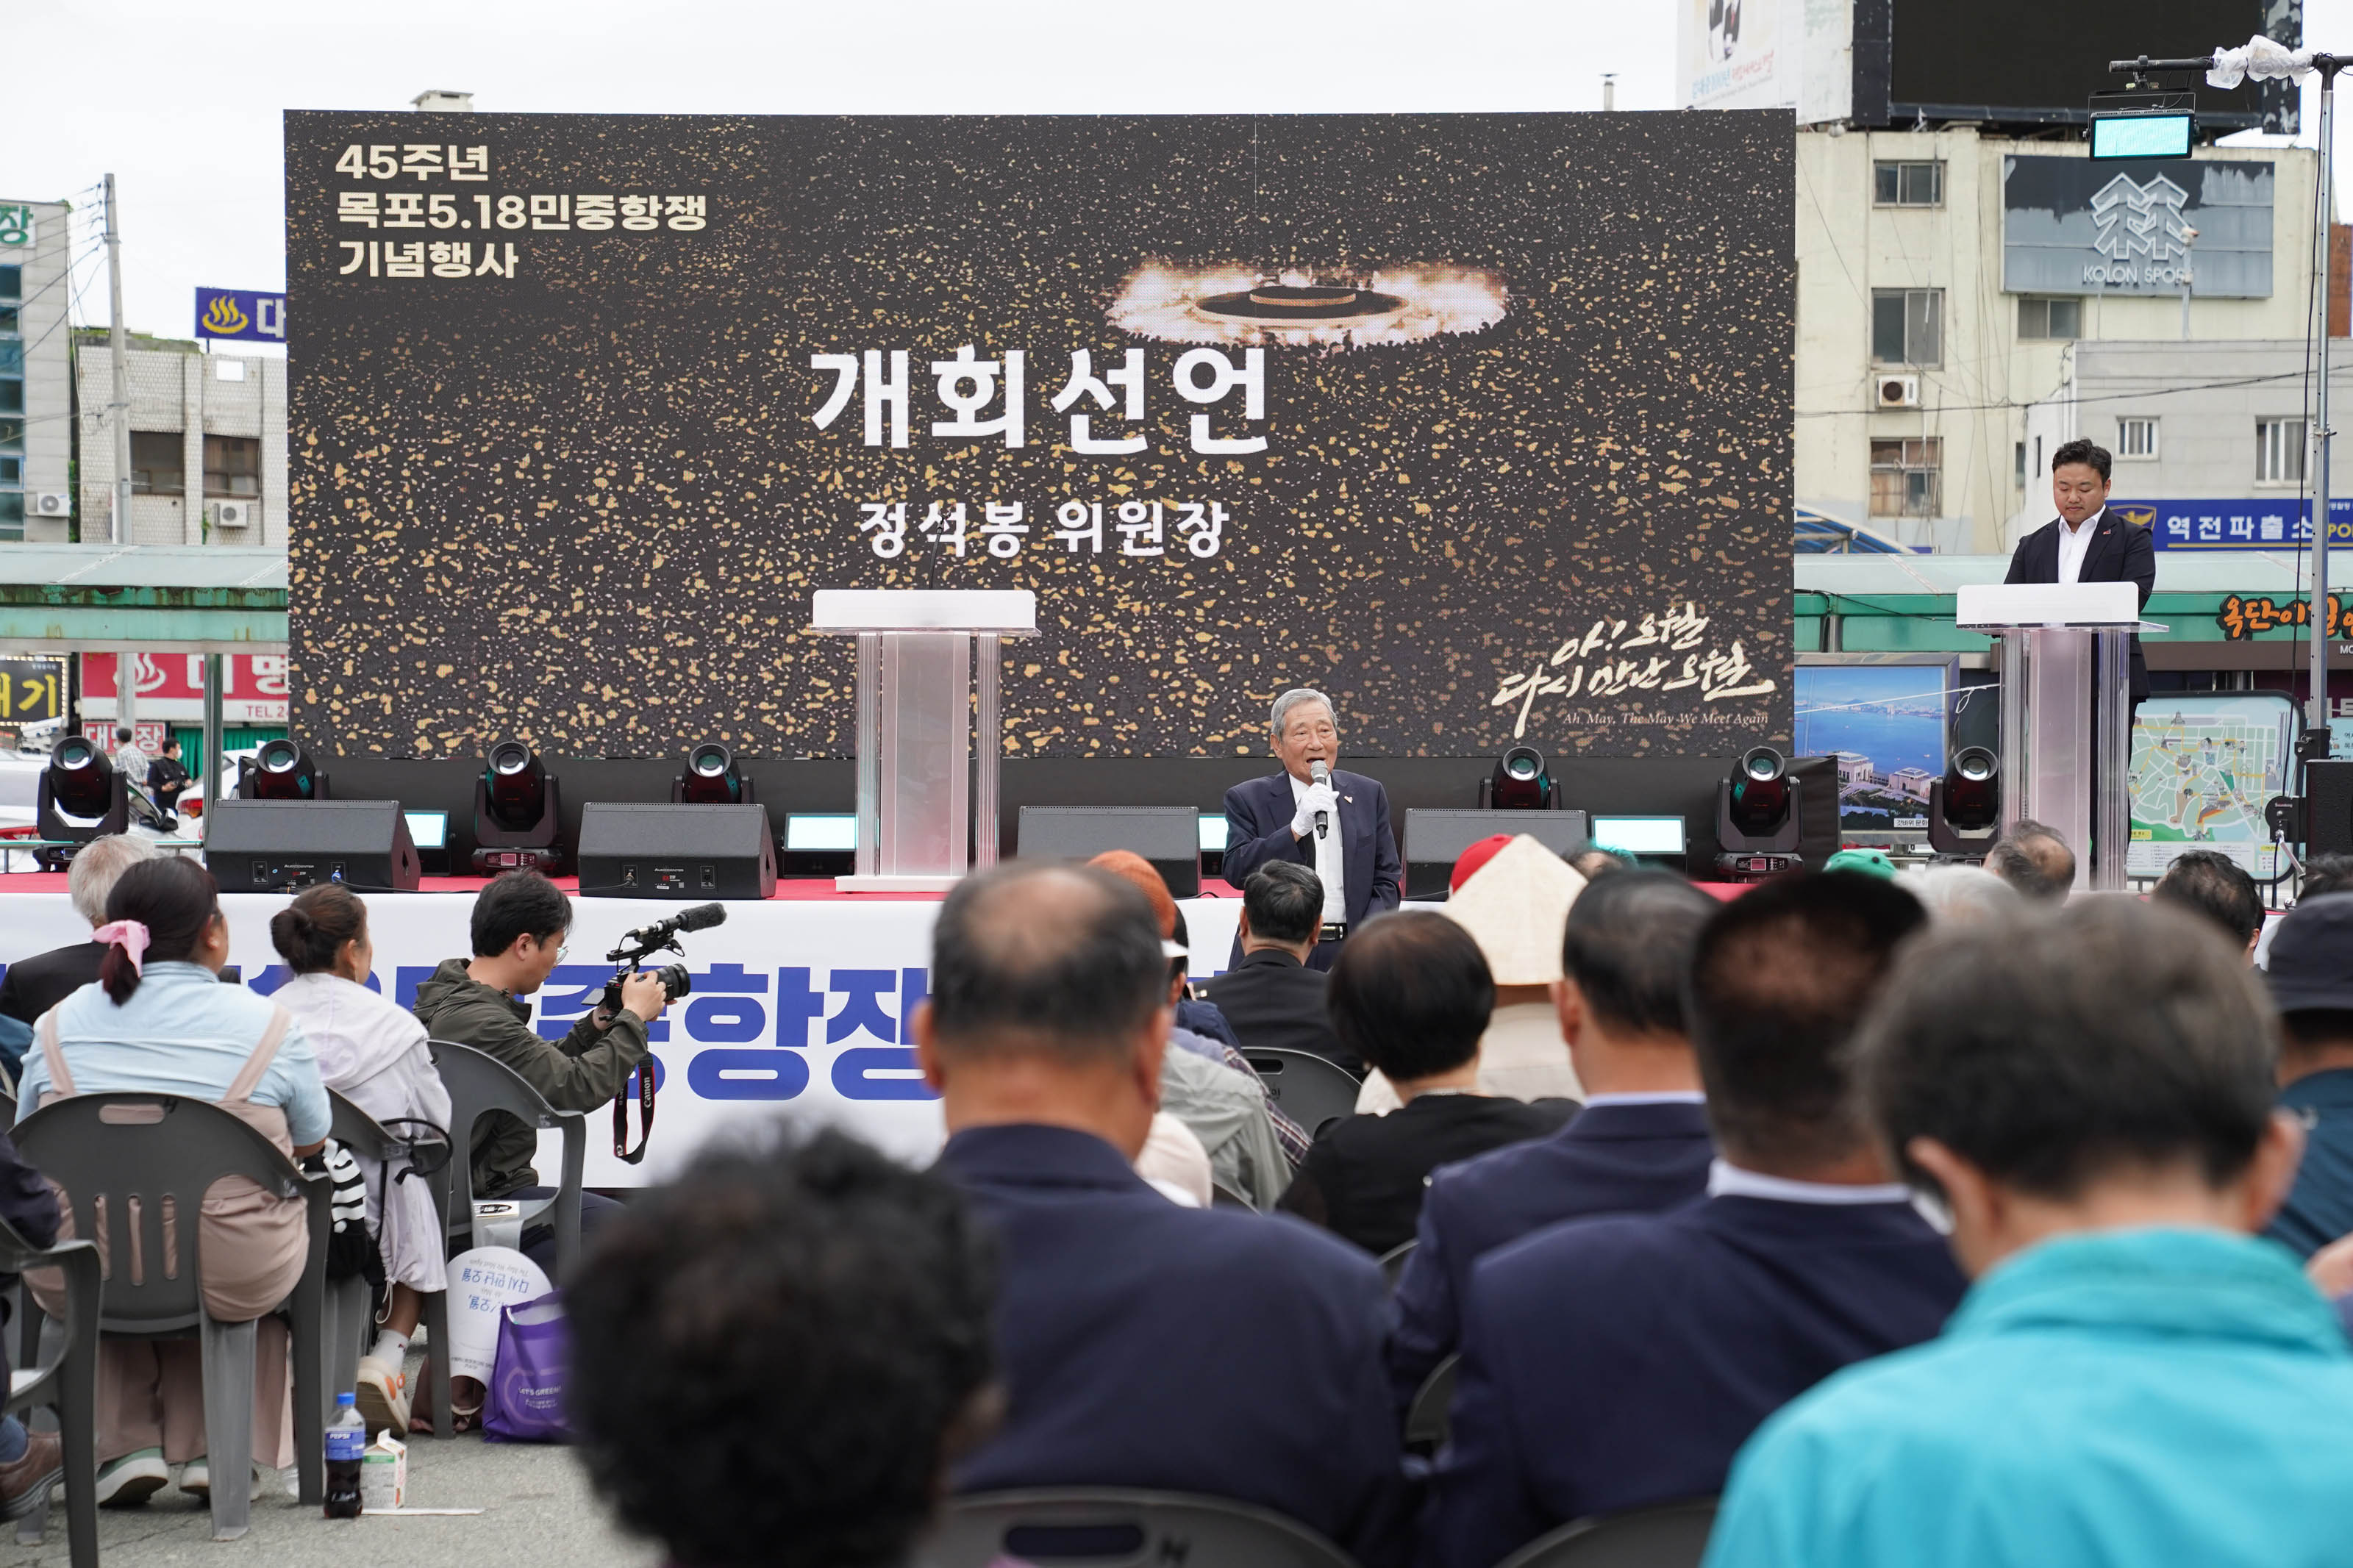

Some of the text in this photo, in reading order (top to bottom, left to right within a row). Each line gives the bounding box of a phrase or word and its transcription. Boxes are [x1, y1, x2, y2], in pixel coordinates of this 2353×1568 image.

[335, 144, 489, 182] 45주년
[337, 191, 707, 232] 목포5.18민중항쟁
[339, 240, 519, 279] 기념행사
[2083, 265, 2194, 284] KOLON SPOR
[860, 501, 1229, 559] 정석봉 위원장
[2167, 515, 2313, 541] 역전파출소
[2328, 523, 2353, 539] PO
[1551, 601, 1710, 666] 아! 오월
[1491, 642, 1777, 739] 다시 만난 오월
[246, 706, 273, 718] TEL
[1622, 712, 1646, 725] The
[1646, 712, 1674, 726] May
[1678, 712, 1698, 725] We
[1701, 712, 1732, 725] Meet
[1733, 712, 1769, 727] Again
[85, 724, 163, 751] 대장
[644, 1076, 652, 1109] Canon
[484, 1271, 506, 1289] 만난
[508, 1275, 530, 1294] 다시
